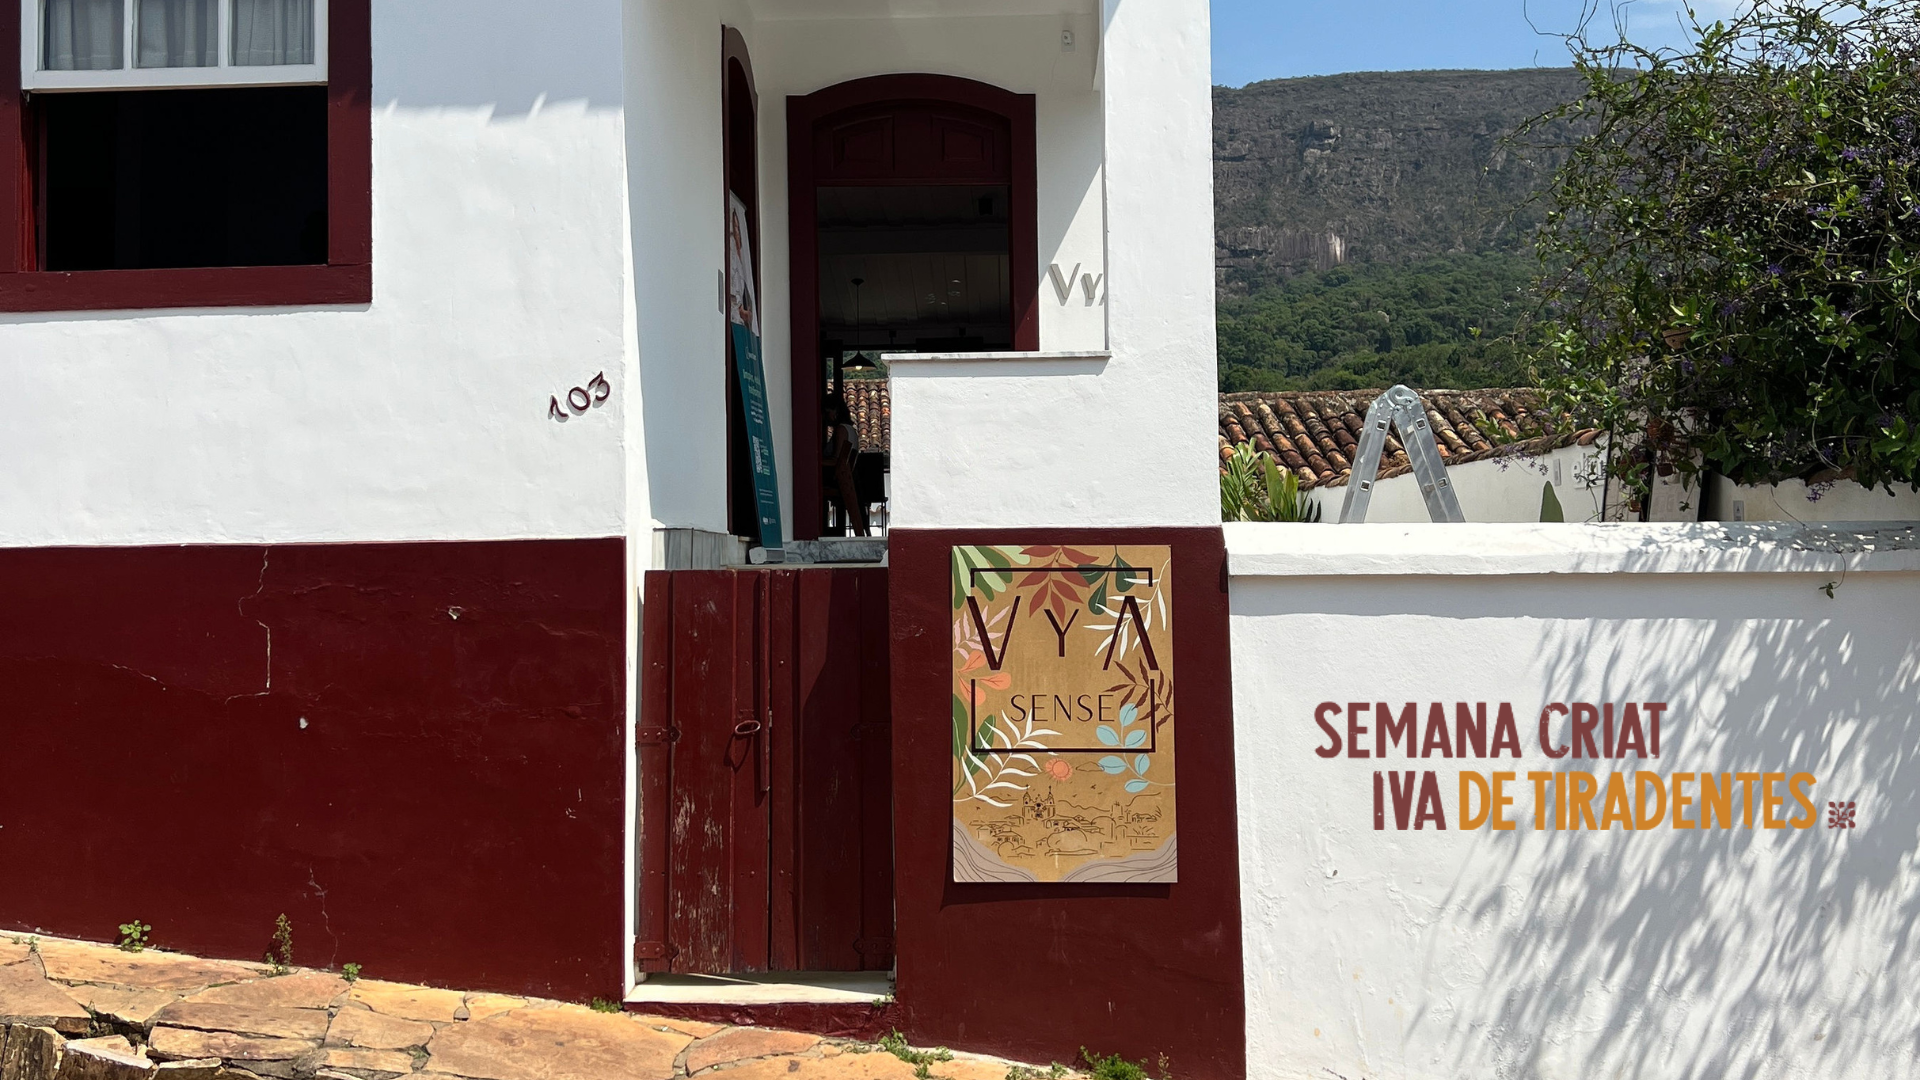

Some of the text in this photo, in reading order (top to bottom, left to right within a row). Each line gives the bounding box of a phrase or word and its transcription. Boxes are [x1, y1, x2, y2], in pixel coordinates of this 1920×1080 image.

[1048, 262, 1104, 307] VY
[549, 370, 611, 418] 103
[966, 595, 1159, 671] VYA
[1010, 694, 1115, 723] SENSE
